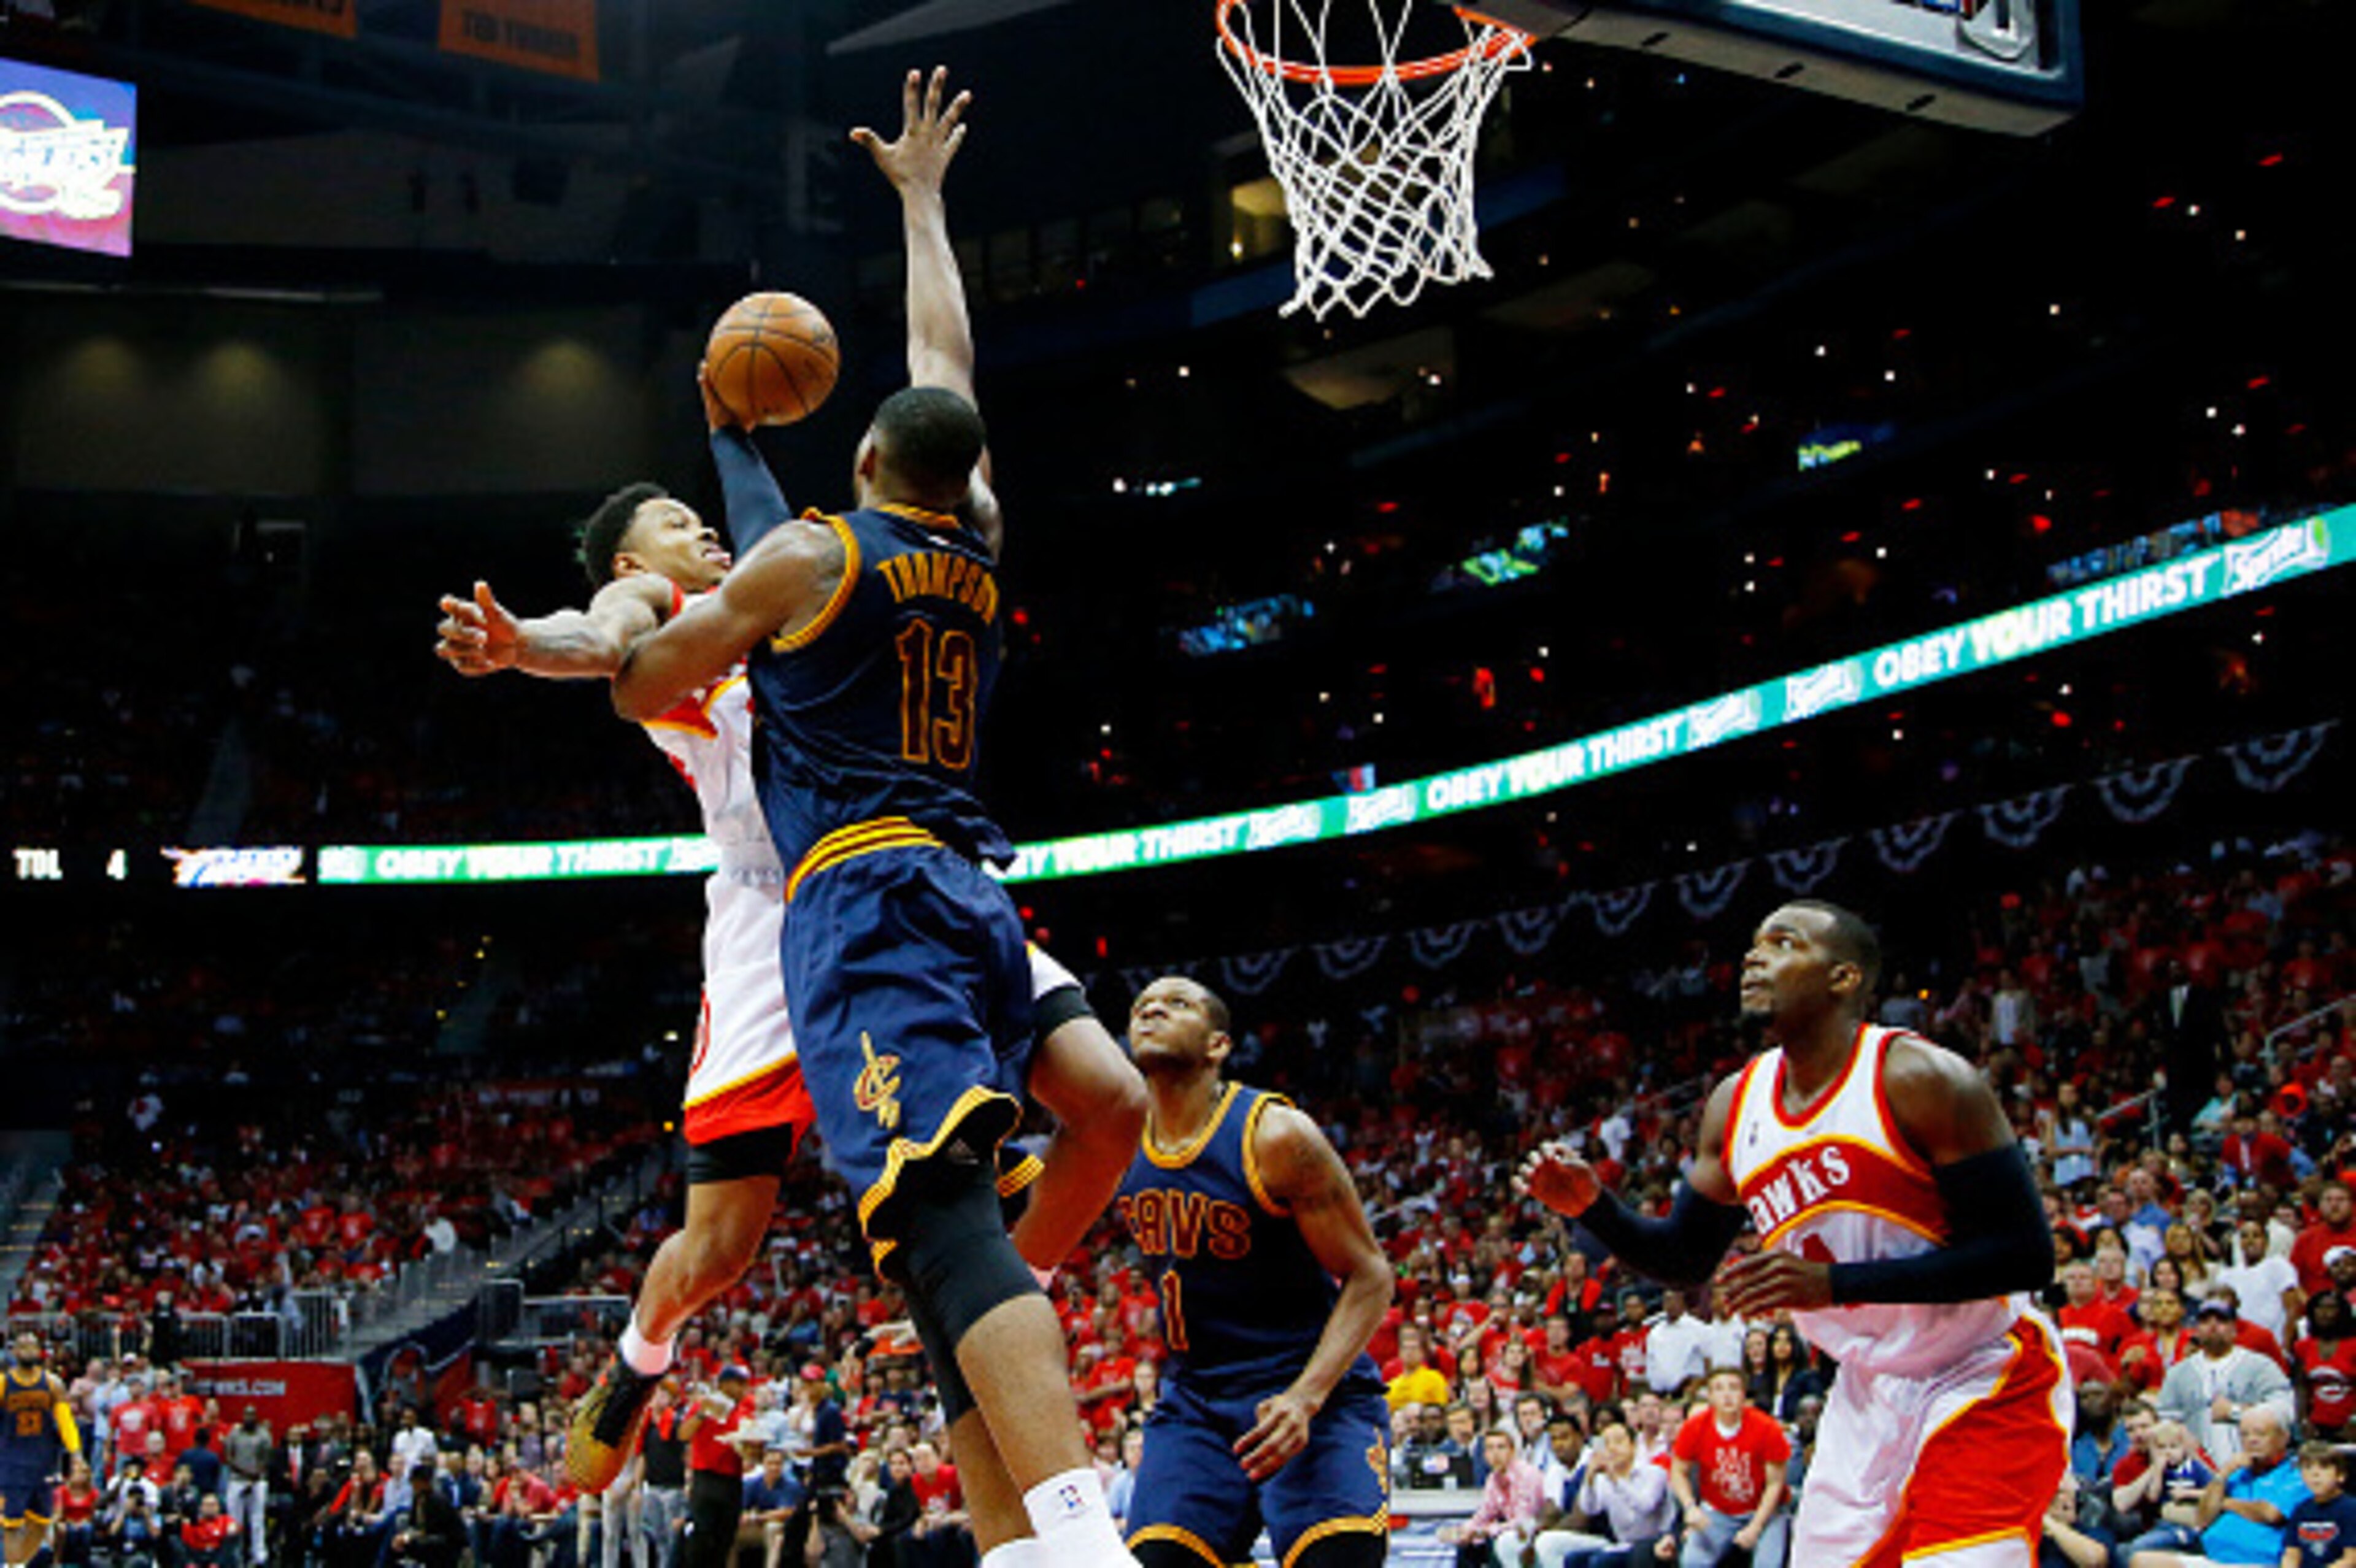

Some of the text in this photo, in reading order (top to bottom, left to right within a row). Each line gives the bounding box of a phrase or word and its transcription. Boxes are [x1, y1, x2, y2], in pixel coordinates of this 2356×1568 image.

[875, 551, 999, 626] THOMPSON
[1873, 629, 1965, 686] OBEY
[1969, 599, 2073, 663] YOUR
[2076, 553, 2220, 628] THIRST
[896, 617, 978, 771] 13
[1426, 764, 1504, 811] OBEY
[1507, 743, 1585, 794] YOUR
[1587, 712, 1686, 770] THIRST
[106, 848, 126, 880] 4
[375, 849, 465, 878] OBEY
[556, 840, 669, 874] THIRST
[1141, 815, 1244, 866] THIRST
[1161, 1269, 1189, 1351] 1
